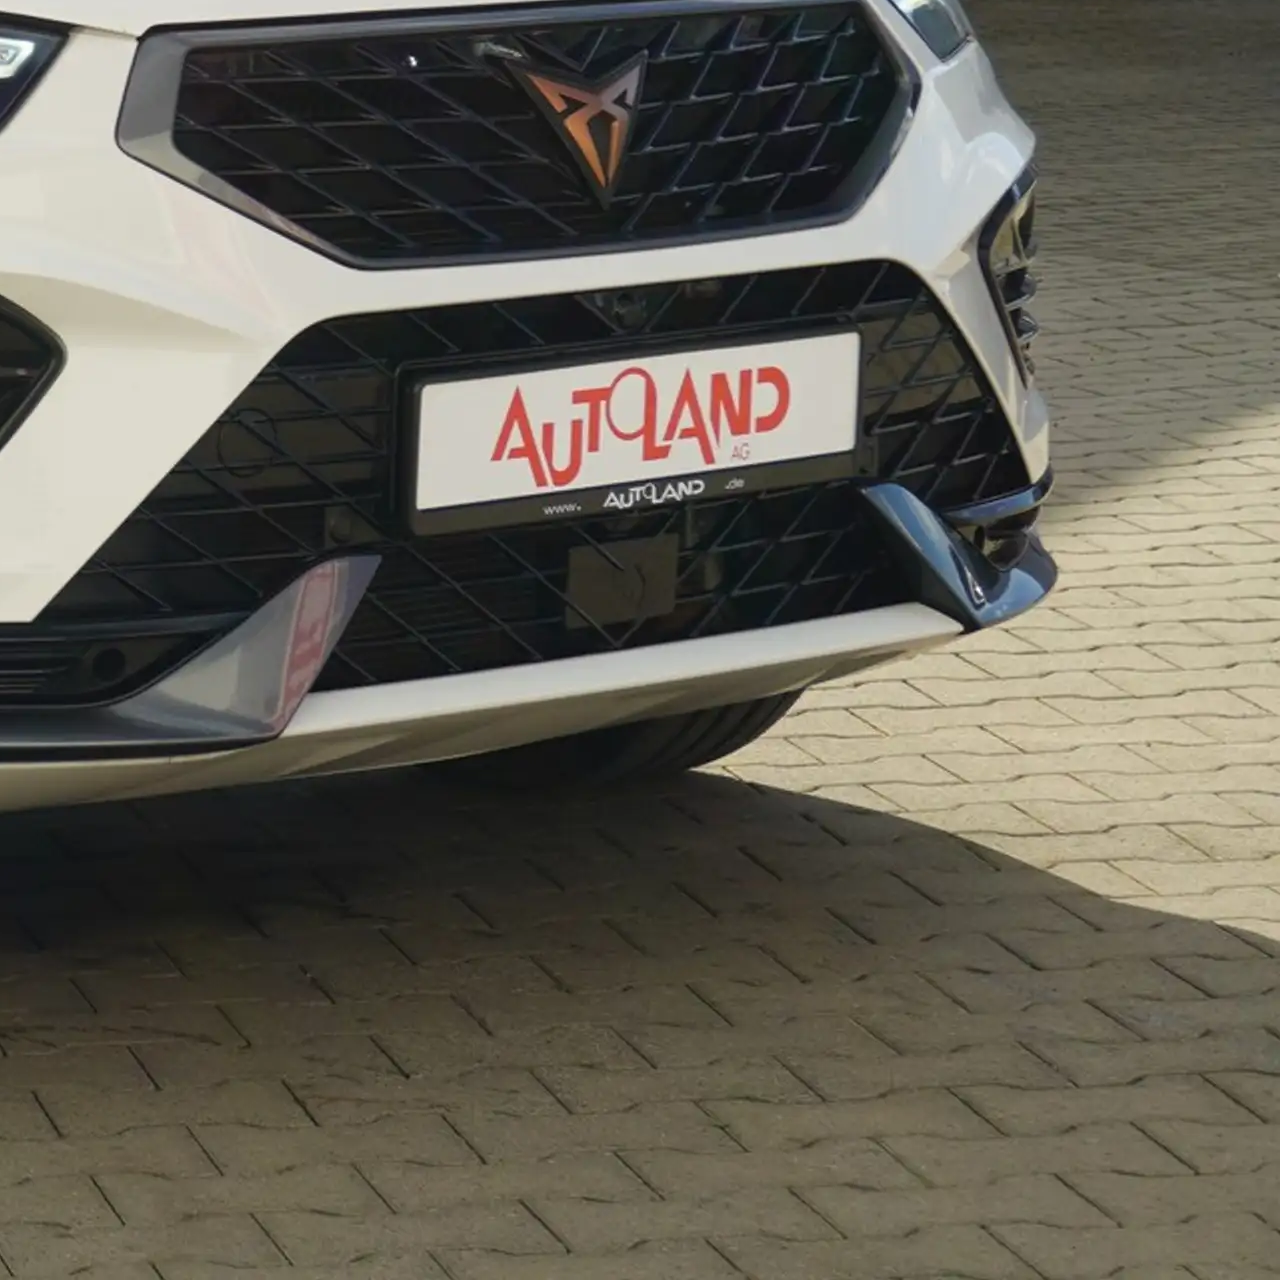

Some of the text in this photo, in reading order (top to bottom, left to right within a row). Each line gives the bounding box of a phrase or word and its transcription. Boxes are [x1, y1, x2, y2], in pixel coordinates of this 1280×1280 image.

[490, 366, 791, 488] AUTOLAND
[731, 442, 751, 461] AG
[603, 479, 706, 510] AUTOLAND
